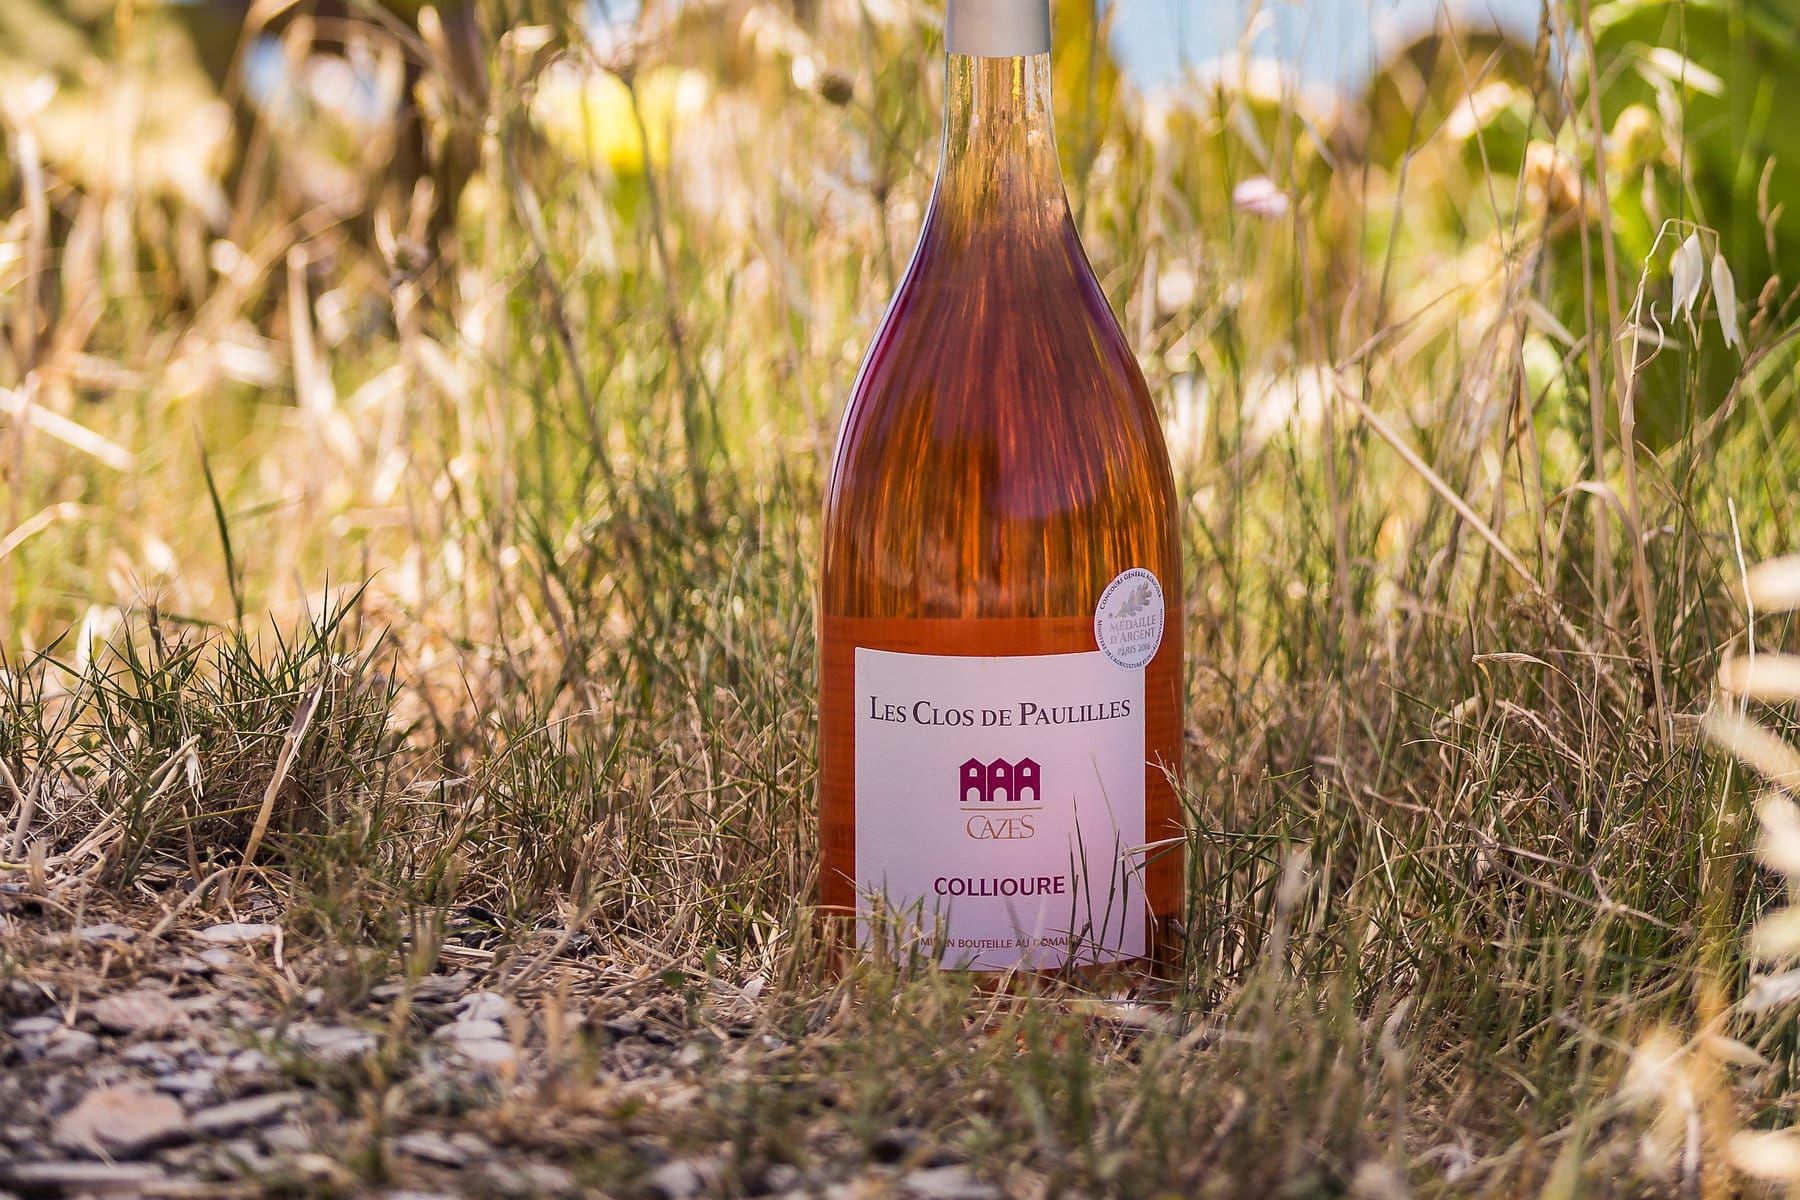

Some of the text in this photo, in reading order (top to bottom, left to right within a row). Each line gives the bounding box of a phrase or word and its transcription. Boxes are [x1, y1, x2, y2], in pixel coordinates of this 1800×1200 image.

[1100, 578, 1123, 609] CONCOURS
[1110, 627, 1155, 644] D'ARGENT
[869, 695, 1132, 727] LES CLOS DE PAULILLES
[966, 814, 1035, 840] CAZES
[933, 875, 1066, 897] COLLIOURE
[920, 937, 938, 947] MI
[958, 938, 1013, 949] BOUTEILLE
[1015, 938, 1030, 948] AU
